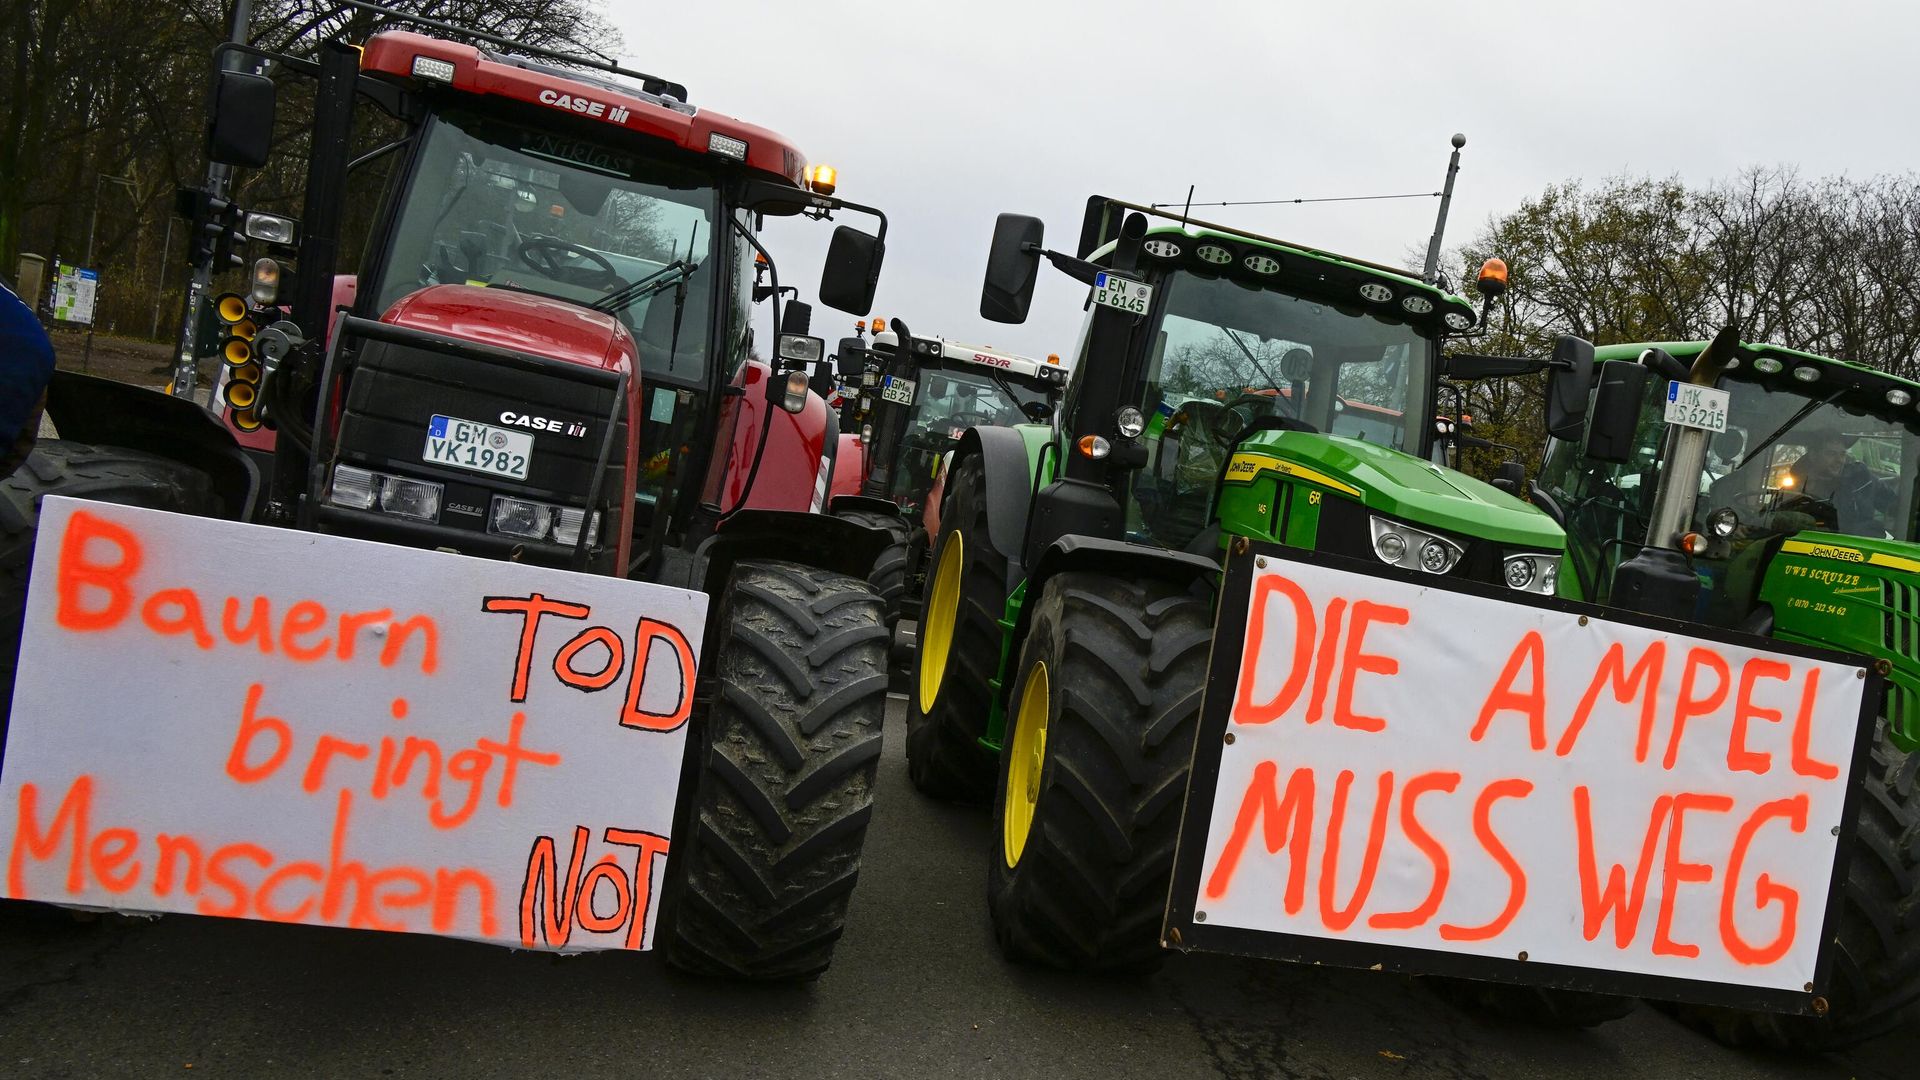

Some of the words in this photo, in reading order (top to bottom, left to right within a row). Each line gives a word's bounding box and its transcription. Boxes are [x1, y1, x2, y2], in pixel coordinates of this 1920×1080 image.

[539, 89, 606, 118] CASE
[1108, 277, 1127, 294] EN
[1098, 289, 1107, 303] B
[1111, 293, 1145, 312] 6145
[972, 354, 1011, 368] STEYR
[891, 379, 906, 391] GM
[883, 389, 897, 400] GB
[898, 392, 912, 404] 21
[1682, 388, 1702, 407] MK
[500, 411, 564, 433] CASE
[1689, 407, 1724, 430] 6215
[455, 422, 488, 446] GM
[448, 502, 474, 512] CASE
[1308, 490, 1321, 505] 6R
[1809, 546, 1832, 558] JOHN
[1831, 548, 1861, 561] DEERE
[55, 509, 439, 675] Bauern
[1794, 599, 1809, 609] 0170
[1826, 604, 1836, 614] 54
[1836, 606, 1847, 616] 62
[1232, 573, 1411, 732] DIE
[1468, 630, 1840, 780] AMPEL
[225, 682, 561, 829] bringt
[7, 774, 497, 937] Menschen
[518, 825, 670, 950] NOT
[1204, 760, 1534, 942] MUSS
[1574, 785, 1810, 965] WEG
